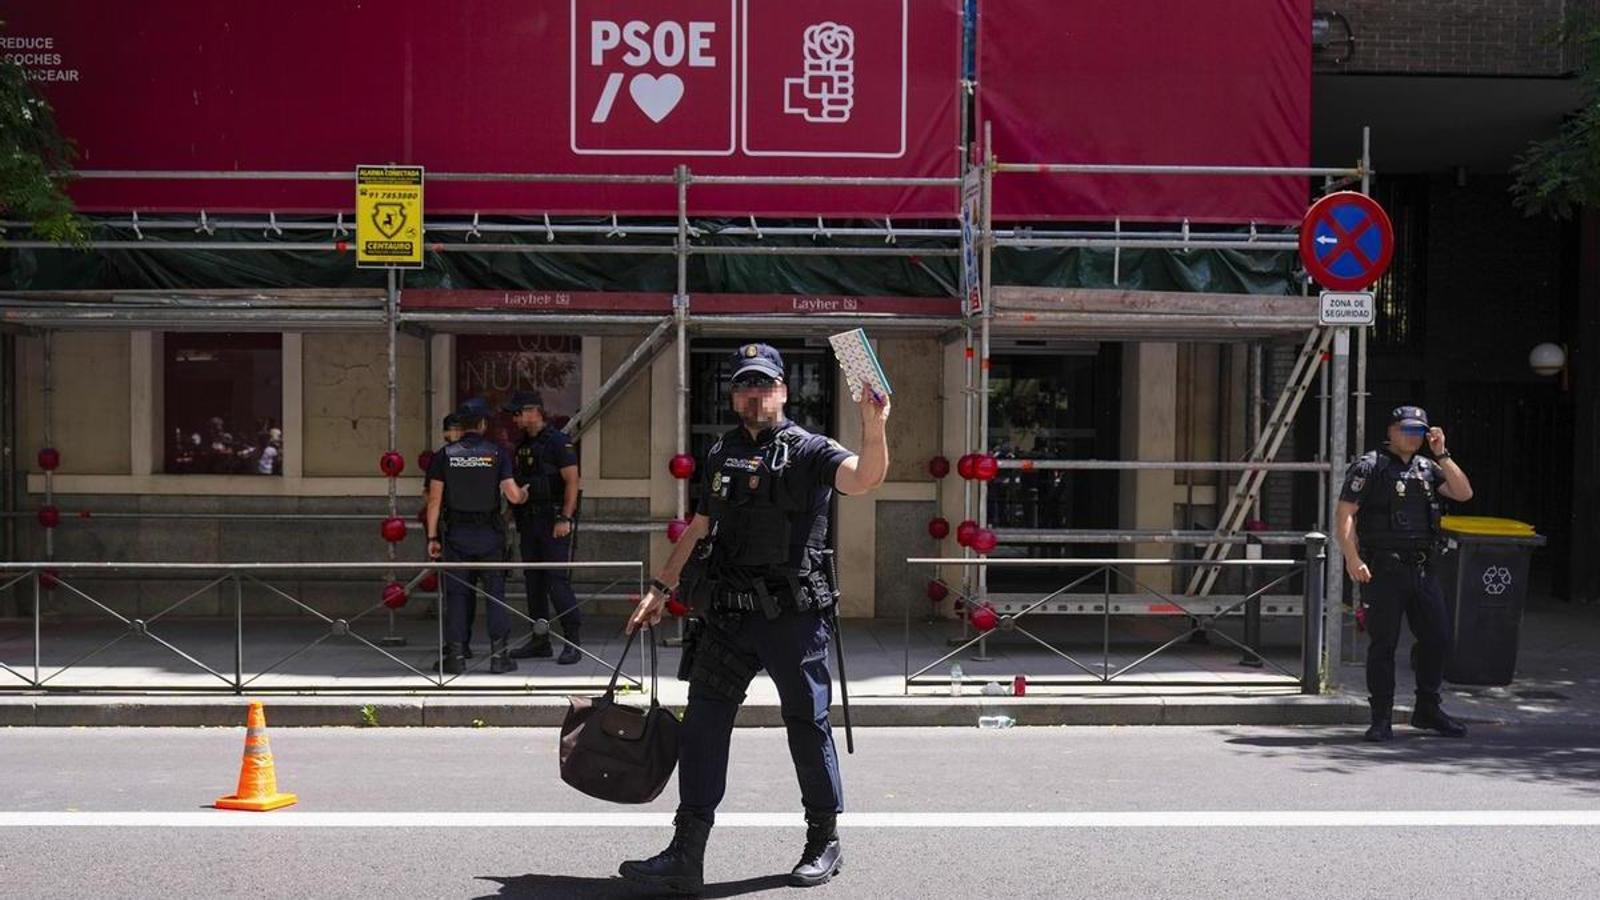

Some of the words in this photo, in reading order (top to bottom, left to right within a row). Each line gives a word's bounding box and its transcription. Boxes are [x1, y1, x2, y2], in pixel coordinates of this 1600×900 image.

[591, 20, 717, 67] PSOE
[504, 293, 551, 305] Layher
[792, 298, 839, 312] Layher
[1324, 310, 1369, 318] SEGURIDAD
